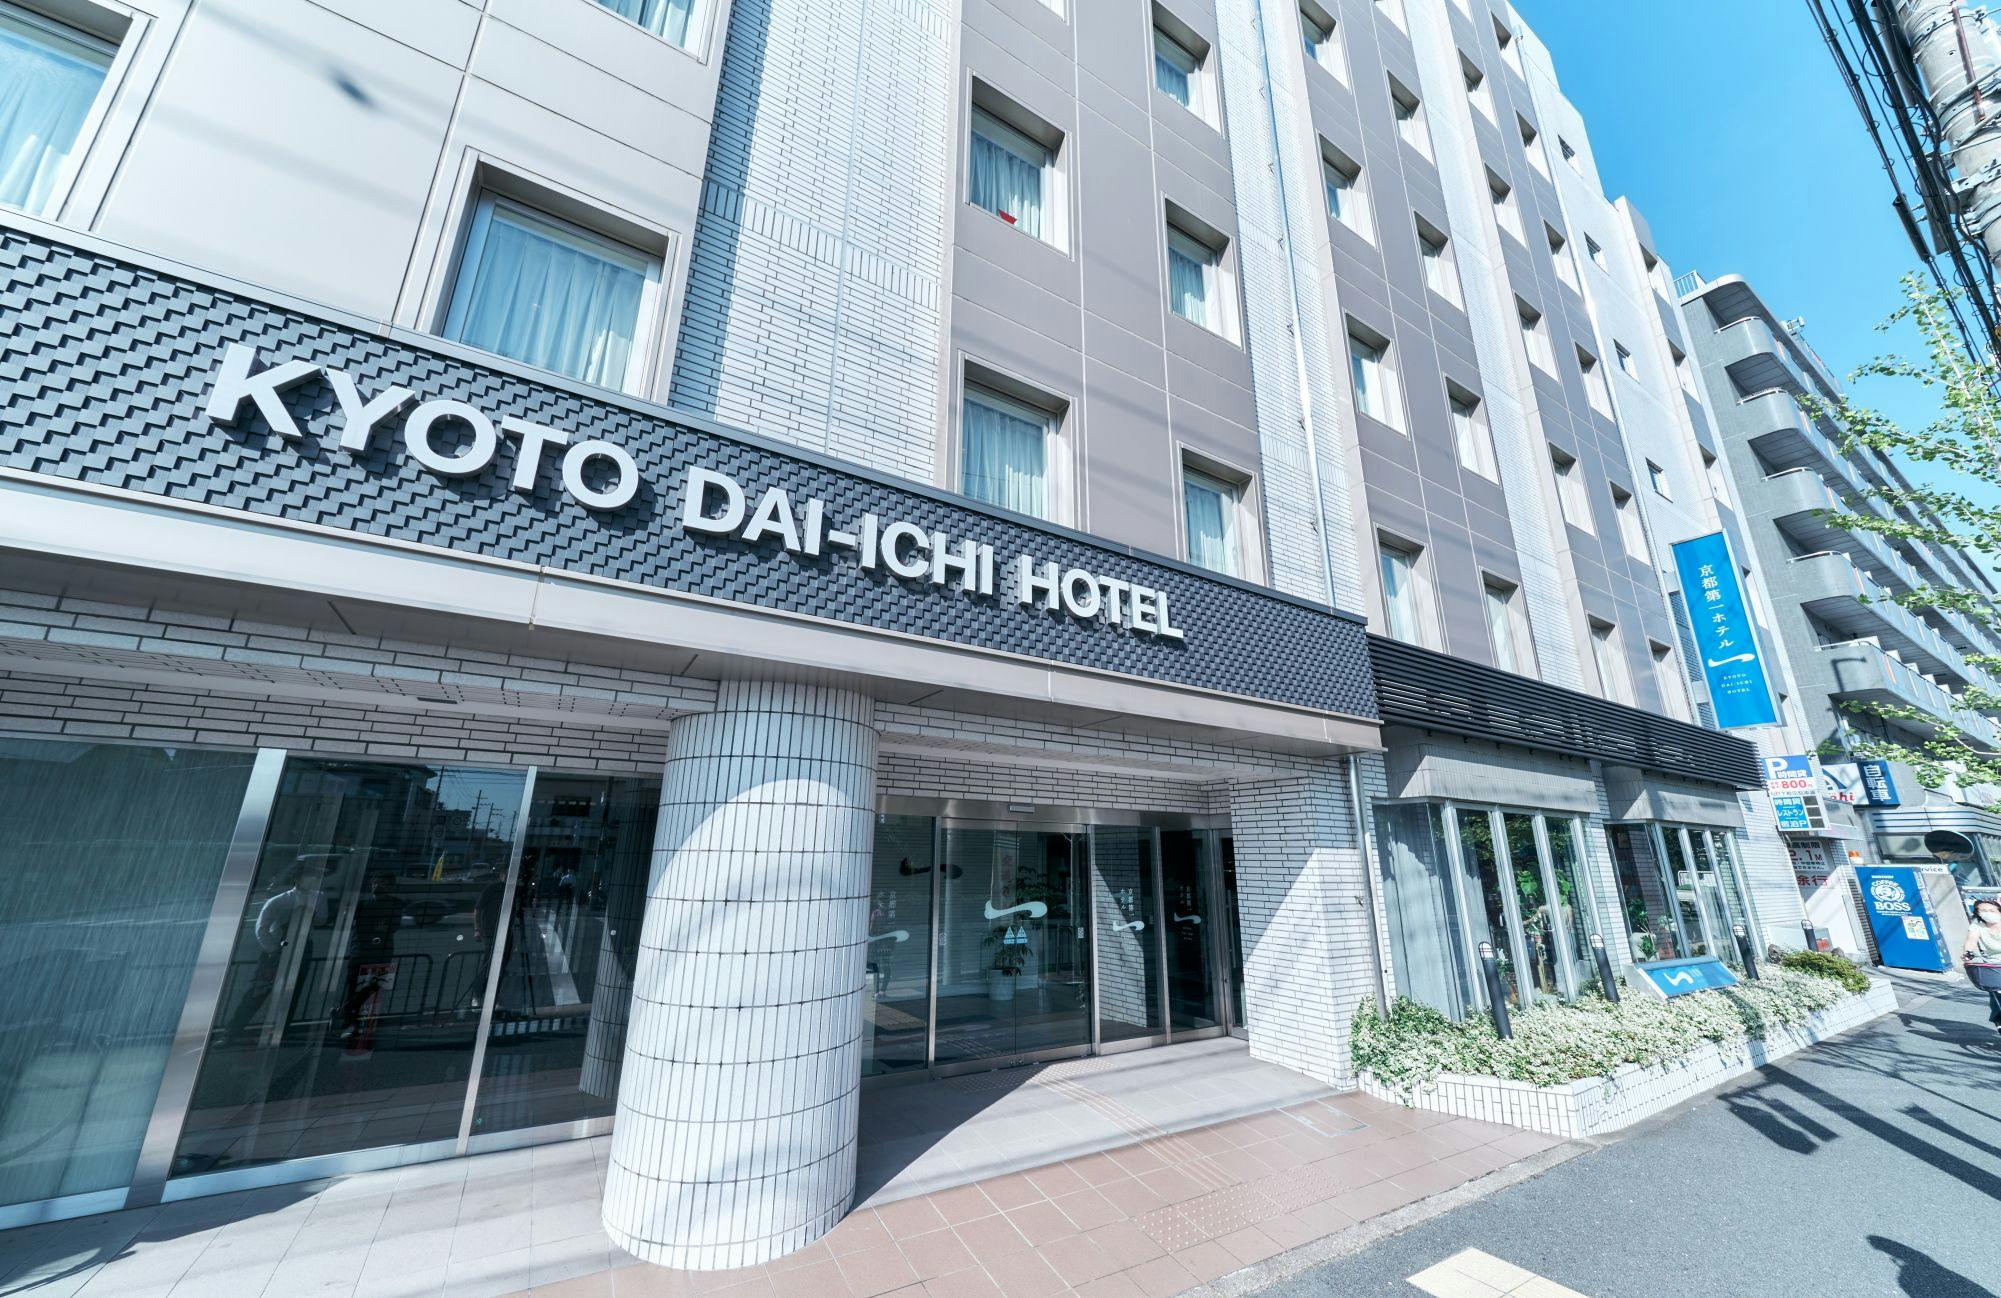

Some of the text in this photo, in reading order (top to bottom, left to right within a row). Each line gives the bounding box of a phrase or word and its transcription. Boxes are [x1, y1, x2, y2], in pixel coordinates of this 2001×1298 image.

[205, 342, 1184, 639] KYOTO DAI-ICHI HOTEL
[1699, 564, 1734, 649] 京都第一ホテル
[1765, 757, 1788, 779] P
[1863, 764, 1892, 802] 自転車
[1777, 808, 1804, 817] レストラン
[1873, 901, 1911, 911] BOSS
